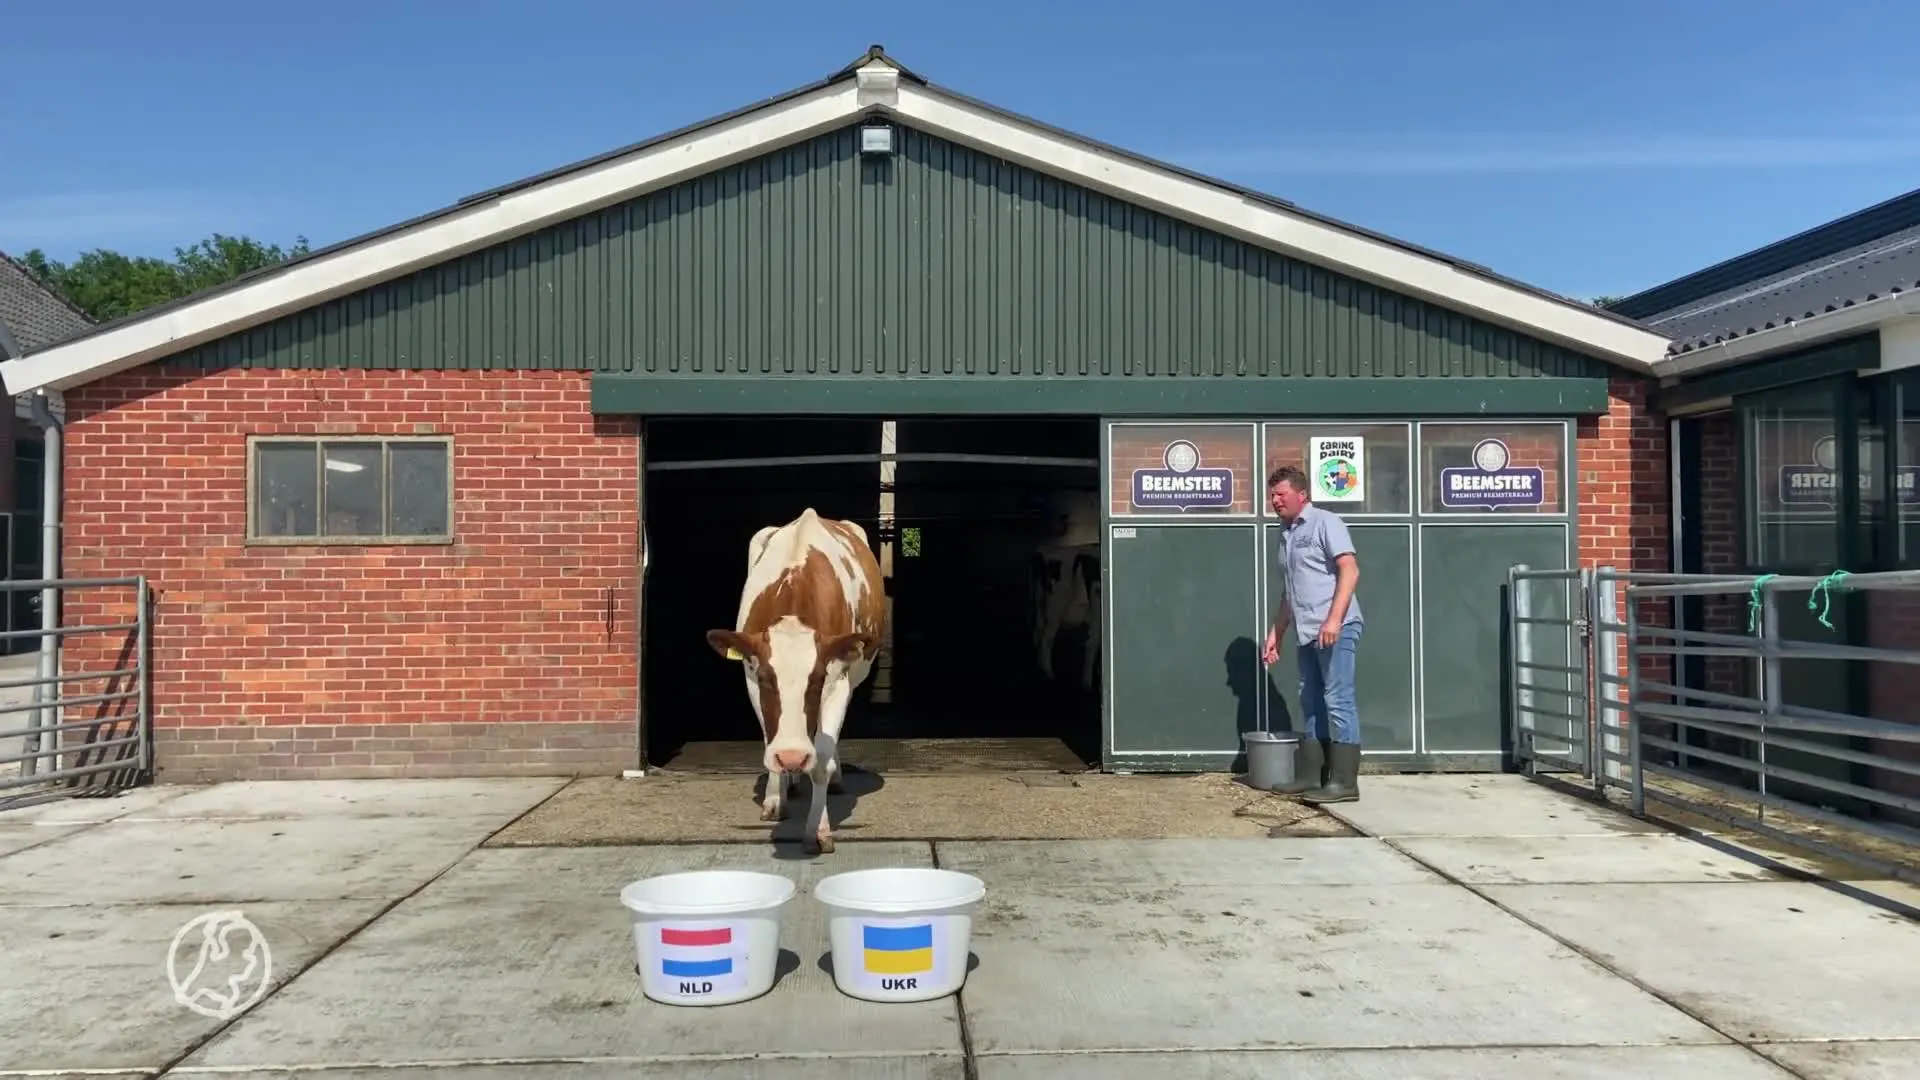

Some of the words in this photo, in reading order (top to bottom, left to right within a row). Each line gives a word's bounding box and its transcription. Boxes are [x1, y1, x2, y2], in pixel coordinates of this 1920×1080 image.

[1142, 475, 1222, 491] BEEMSTER
[1451, 474, 1532, 490] BEEMSTER
[679, 981, 713, 994] NLD
[881, 978, 918, 991] UKR
